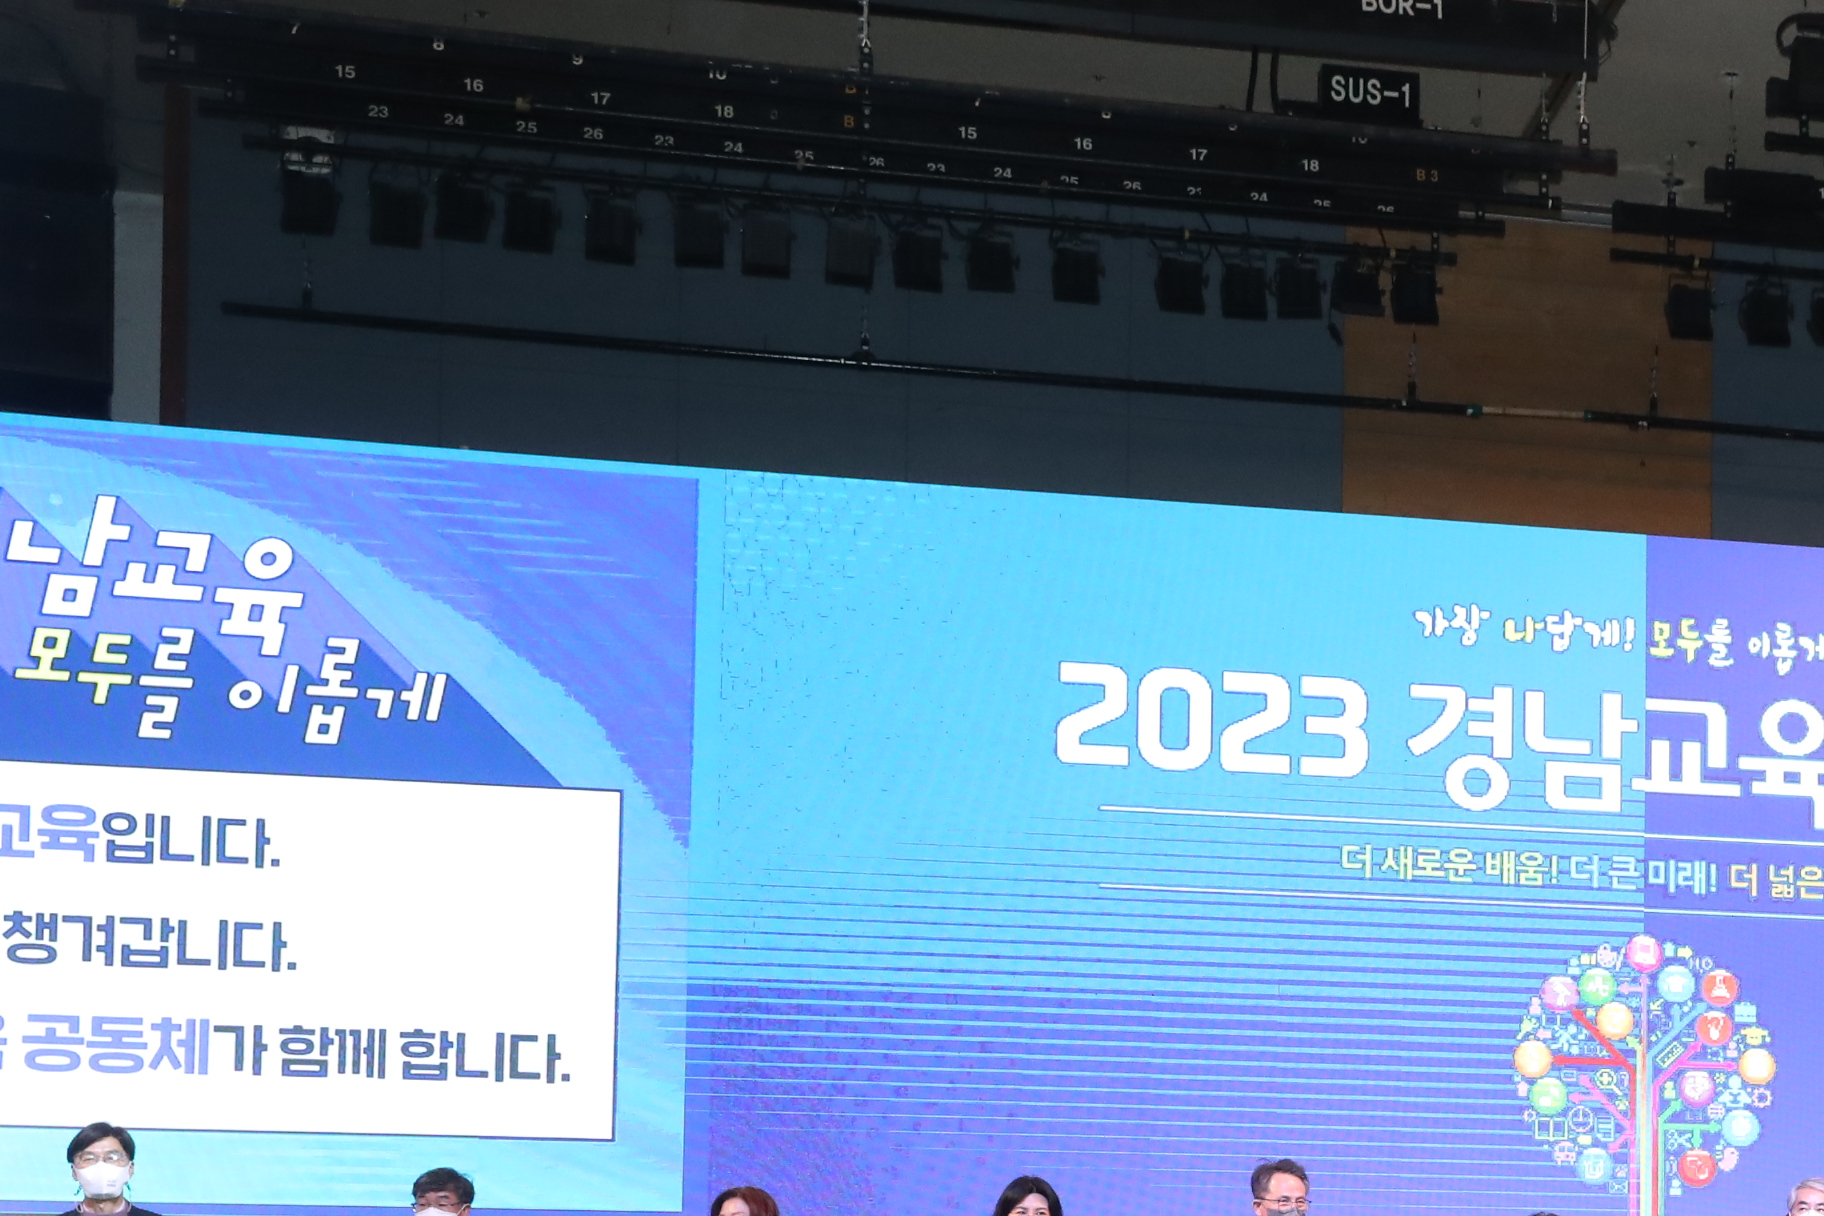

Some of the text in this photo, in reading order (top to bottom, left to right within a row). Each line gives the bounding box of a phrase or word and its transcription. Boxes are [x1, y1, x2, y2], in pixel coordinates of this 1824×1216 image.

[335, 64, 356, 79] 15
[464, 78, 484, 92] 16
[1330, 74, 1411, 109] SUS-1
[590, 91, 611, 105] 17
[368, 105, 389, 118] 23
[714, 105, 734, 119] 18
[444, 113, 465, 127] 24
[516, 121, 537, 134] 25
[583, 127, 604, 140] 26
[959, 126, 978, 140] 15
[1074, 137, 1093, 150] 16
[1189, 148, 1208, 161] 17
[1301, 159, 1320, 173] 18
[1413, 603, 1491, 646] 가장
[1502, 609, 1635, 653] 나답게!
[1649, 616, 1735, 668] 모두를
[15, 626, 449, 746] 모두를 이롭게
[1055, 661, 1370, 778] 2023
[1341, 844, 1373, 880] 더
[1381, 845, 1477, 882] 새로운
[1485, 850, 1559, 886] 배움!
[1570, 854, 1599, 889] 더
[1607, 854, 1641, 891] 큰
[1648, 859, 1717, 896] 미래!
[1729, 863, 1758, 898] 더
[3, 911, 297, 972] 챙겨갑니다.
[21, 1013, 268, 1076] 공동체가
[279, 1025, 387, 1079] 함께
[400, 1026, 571, 1084] 합니다.
